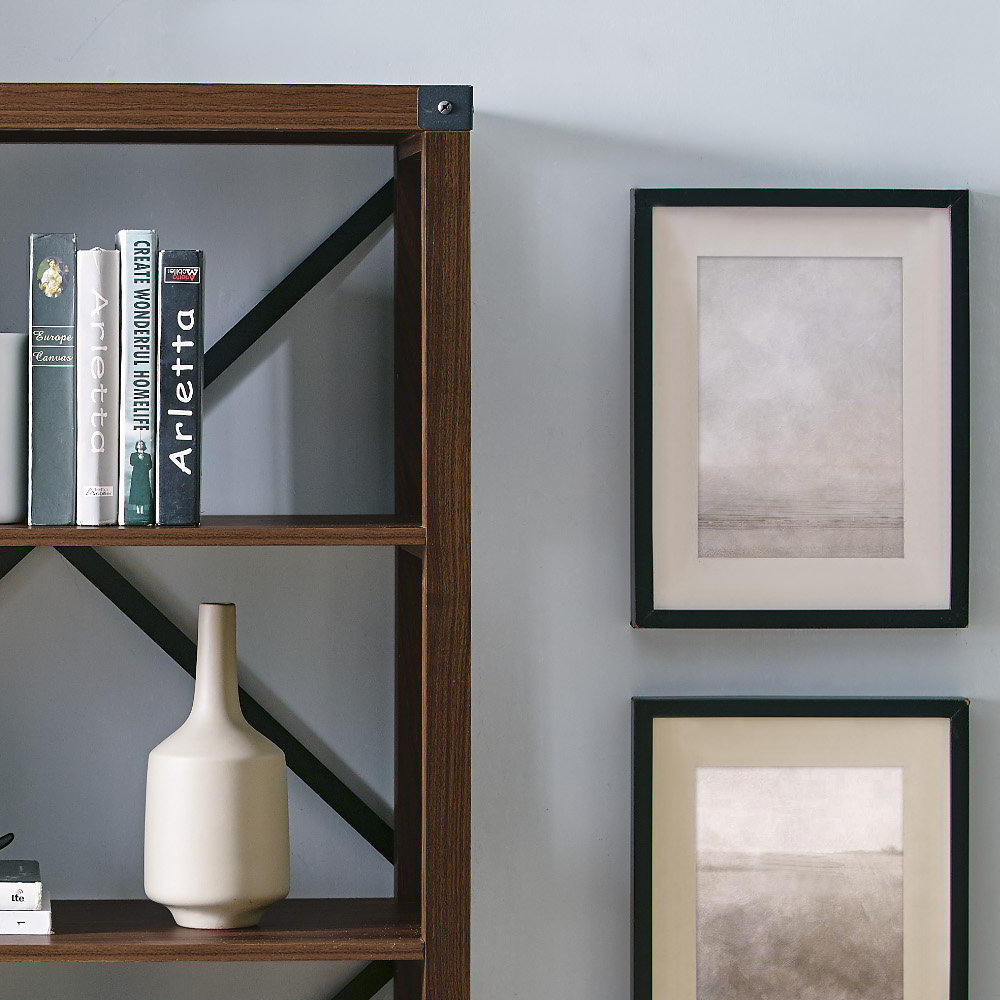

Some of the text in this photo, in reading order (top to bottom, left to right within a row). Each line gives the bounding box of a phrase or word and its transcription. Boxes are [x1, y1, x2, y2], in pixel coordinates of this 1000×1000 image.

[32, 350, 74, 362] Canvas
[33, 330, 74, 344] Europe
[91, 288, 109, 454] Arletta
[133, 240, 151, 432] CREATE WONDERFUL HOMELIFE
[168, 308, 195, 475] Arletta
